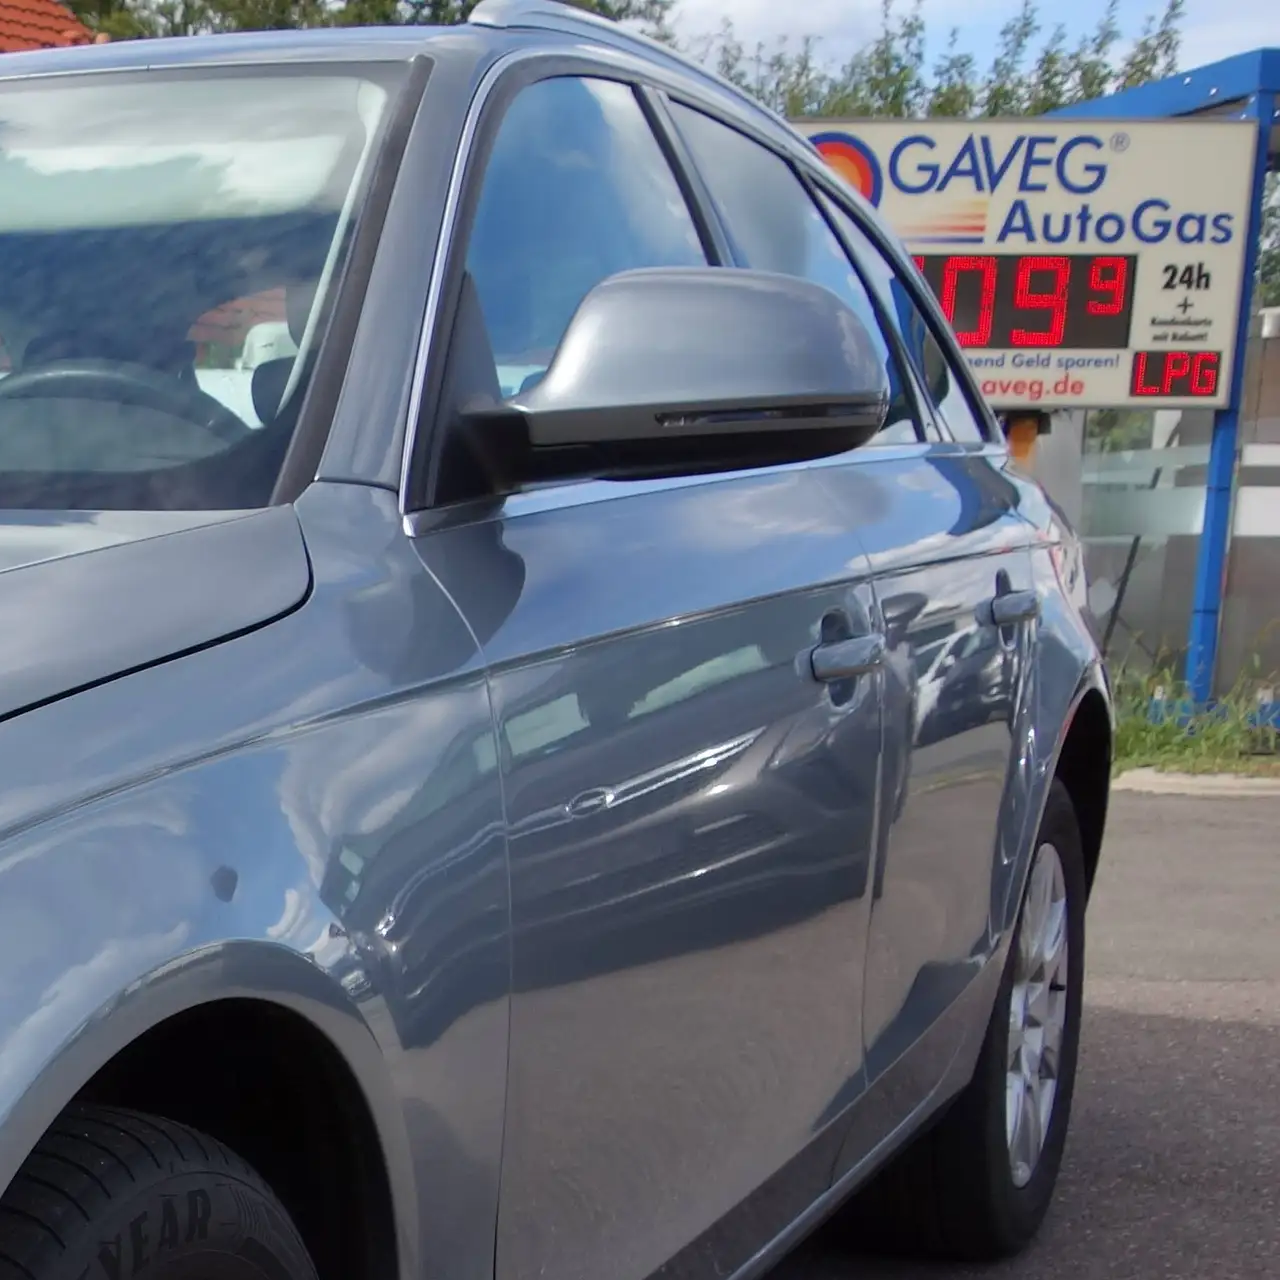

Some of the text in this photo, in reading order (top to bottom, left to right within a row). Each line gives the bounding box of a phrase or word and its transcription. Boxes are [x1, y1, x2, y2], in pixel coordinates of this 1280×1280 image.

[997, 199, 1233, 244] AutoGas
[1162, 262, 1211, 291] 24h
[1011, 353, 1051, 368] Geld
[1056, 354, 1120, 371] sparen!
[1134, 352, 1218, 395] LPG
